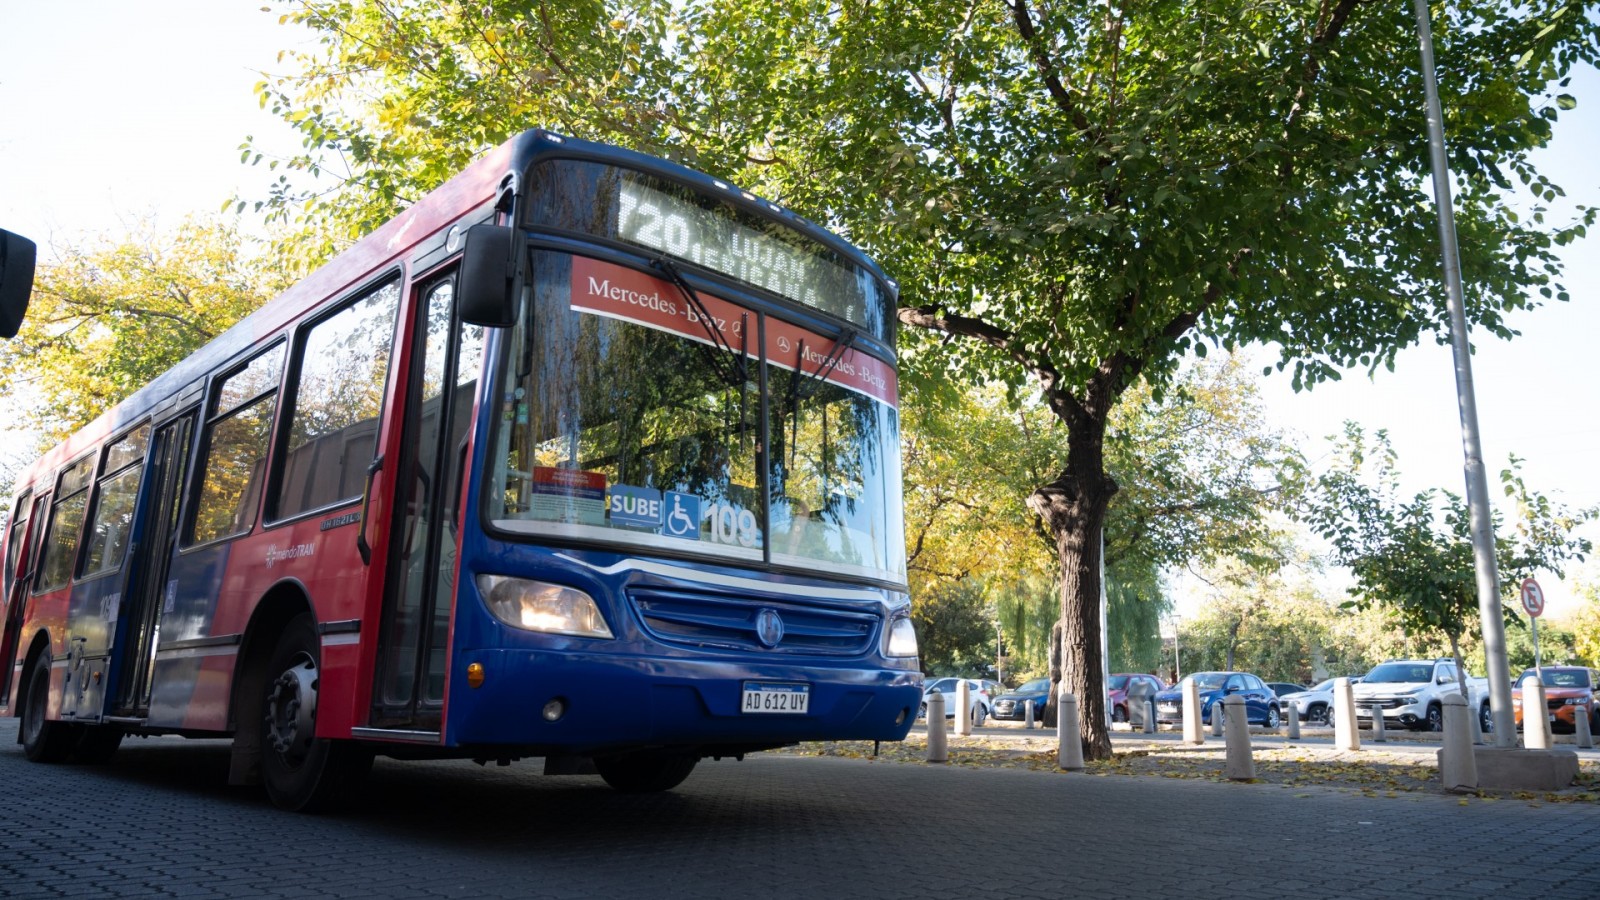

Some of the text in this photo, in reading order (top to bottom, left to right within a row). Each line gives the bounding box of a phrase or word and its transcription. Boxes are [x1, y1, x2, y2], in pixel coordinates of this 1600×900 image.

[618, 192, 689, 256] 720
[611, 492, 659, 518] SUBE
[704, 503, 757, 547] 109
[746, 693, 806, 710] AD 612 UY
